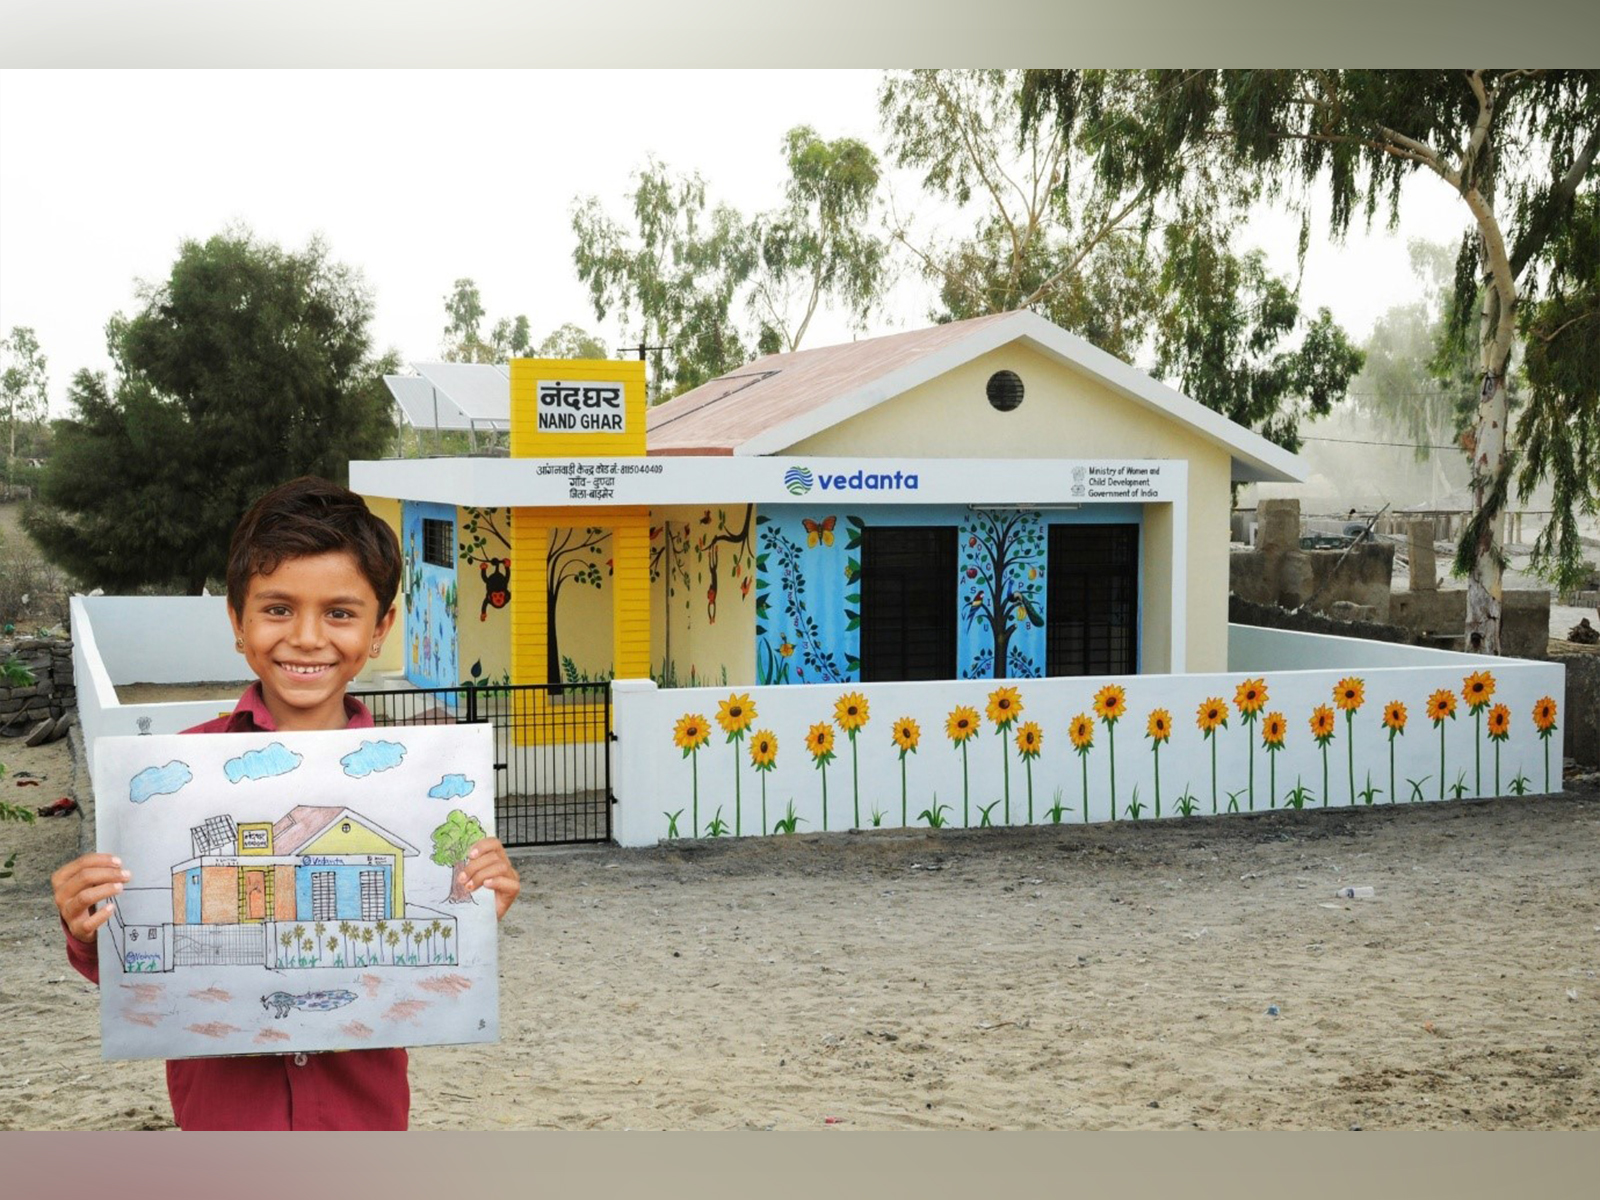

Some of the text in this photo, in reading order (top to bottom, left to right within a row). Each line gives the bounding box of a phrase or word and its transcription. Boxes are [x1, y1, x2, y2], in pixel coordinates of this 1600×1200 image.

[538, 412, 622, 430] NAND GHAR
[1089, 466, 1160, 476] Ministry of Women and
[818, 470, 918, 490] vedanta
[1088, 477, 1106, 486] Child
[1088, 489, 1158, 497] Government of India
